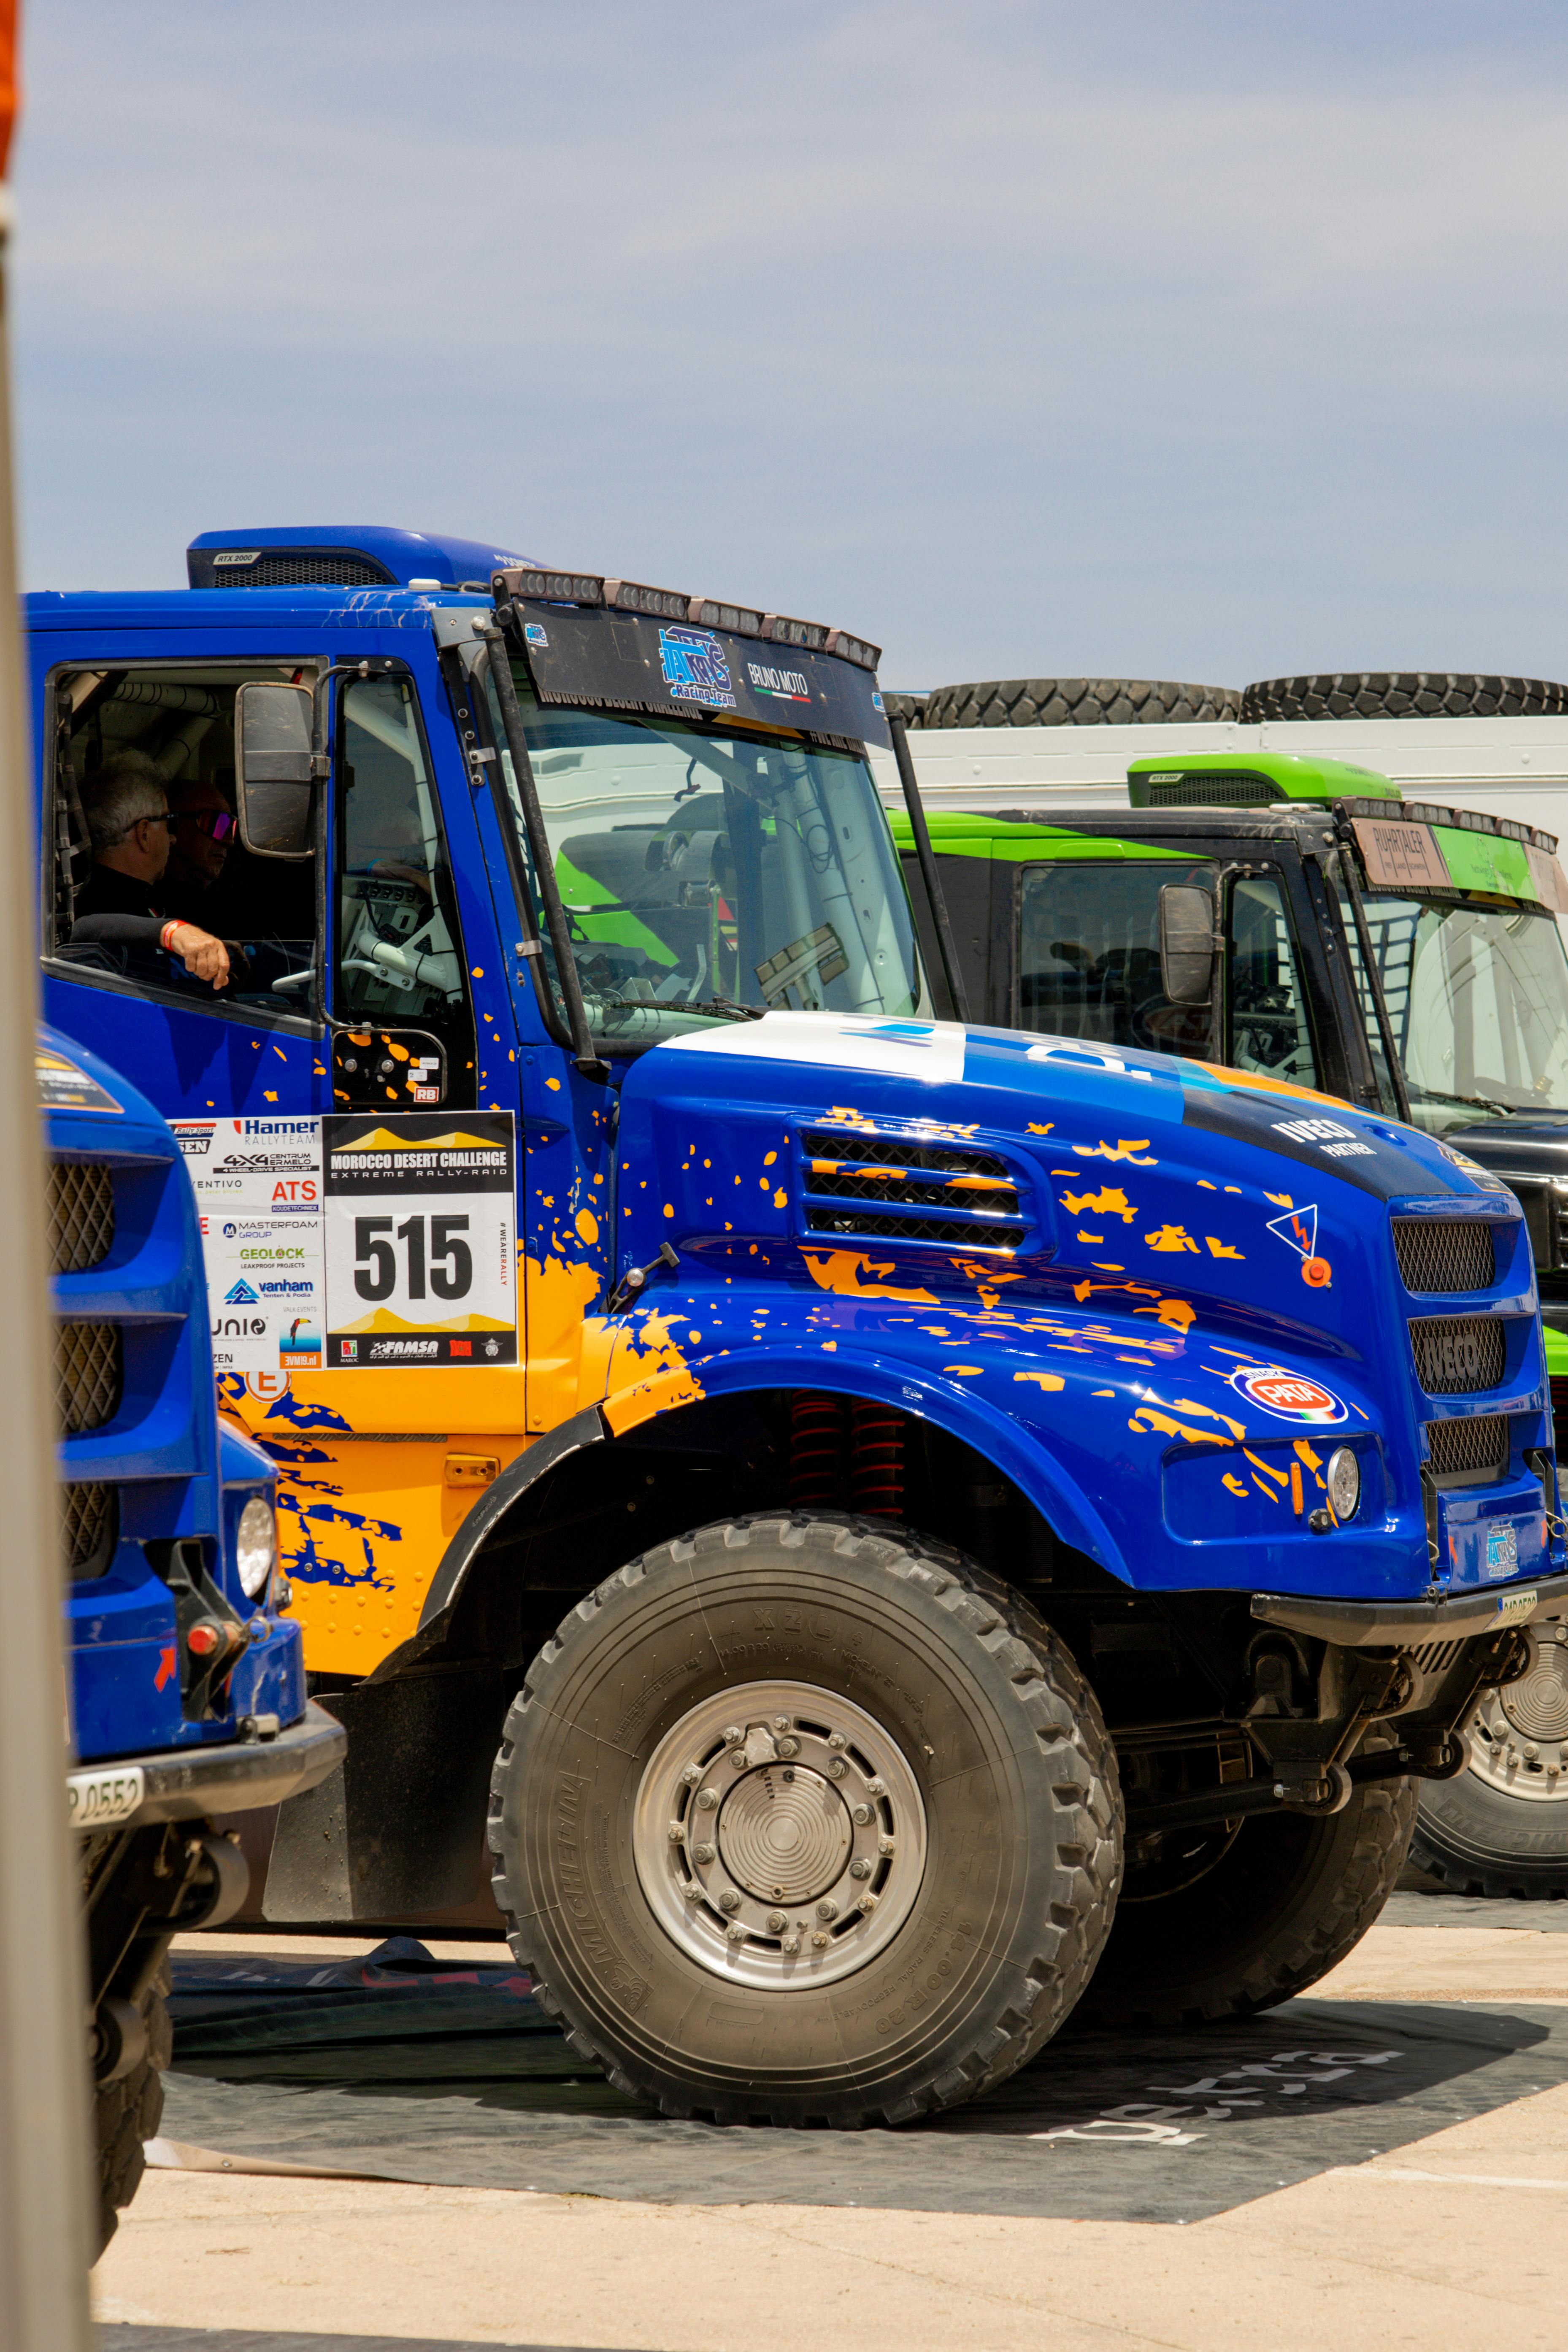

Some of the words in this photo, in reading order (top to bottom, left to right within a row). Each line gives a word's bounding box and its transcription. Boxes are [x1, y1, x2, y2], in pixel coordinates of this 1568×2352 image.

[747, 662, 781, 690] BRUNO
[778, 670, 808, 695] MOTO
[674, 683, 711, 704] Racing
[710, 688, 737, 708] Team
[1373, 827, 1428, 858] RUHRTALER
[417, 1089, 436, 1100] RB
[245, 1120, 319, 1135] Hamer
[1271, 1119, 1357, 1143] IVECO
[245, 1135, 315, 1145] RALLYTEAM
[1319, 1143, 1377, 1157] PARTNER
[330, 1154, 392, 1170] MOROCCO
[394, 1153, 439, 1168] DESERT
[440, 1152, 507, 1168] CHALLENGE
[416, 1169, 507, 1177] RALLY-RAID
[272, 1180, 316, 1201] ATS
[239, 1221, 318, 1229] MASTERFOAM
[240, 1248, 305, 1260] GEOLOCK
[354, 1214, 473, 1301] 515
[258, 1279, 314, 1292] vanham
[1423, 1333, 1478, 1382] IVECO
[259, 1371, 277, 1391] E
[1256, 1384, 1325, 1403] PATA
[80, 1778, 138, 1821] 0552
[558, 1776, 614, 1965] MICHELIN
[925, 1909, 950, 1954] TUBELESS
[926, 1921, 973, 1990] 14.00
[898, 1957, 923, 1984] RADIAL
[833, 1984, 897, 2021] REGROOVABLE
[905, 1989, 928, 2011] R
[876, 2006, 905, 2034] 20
